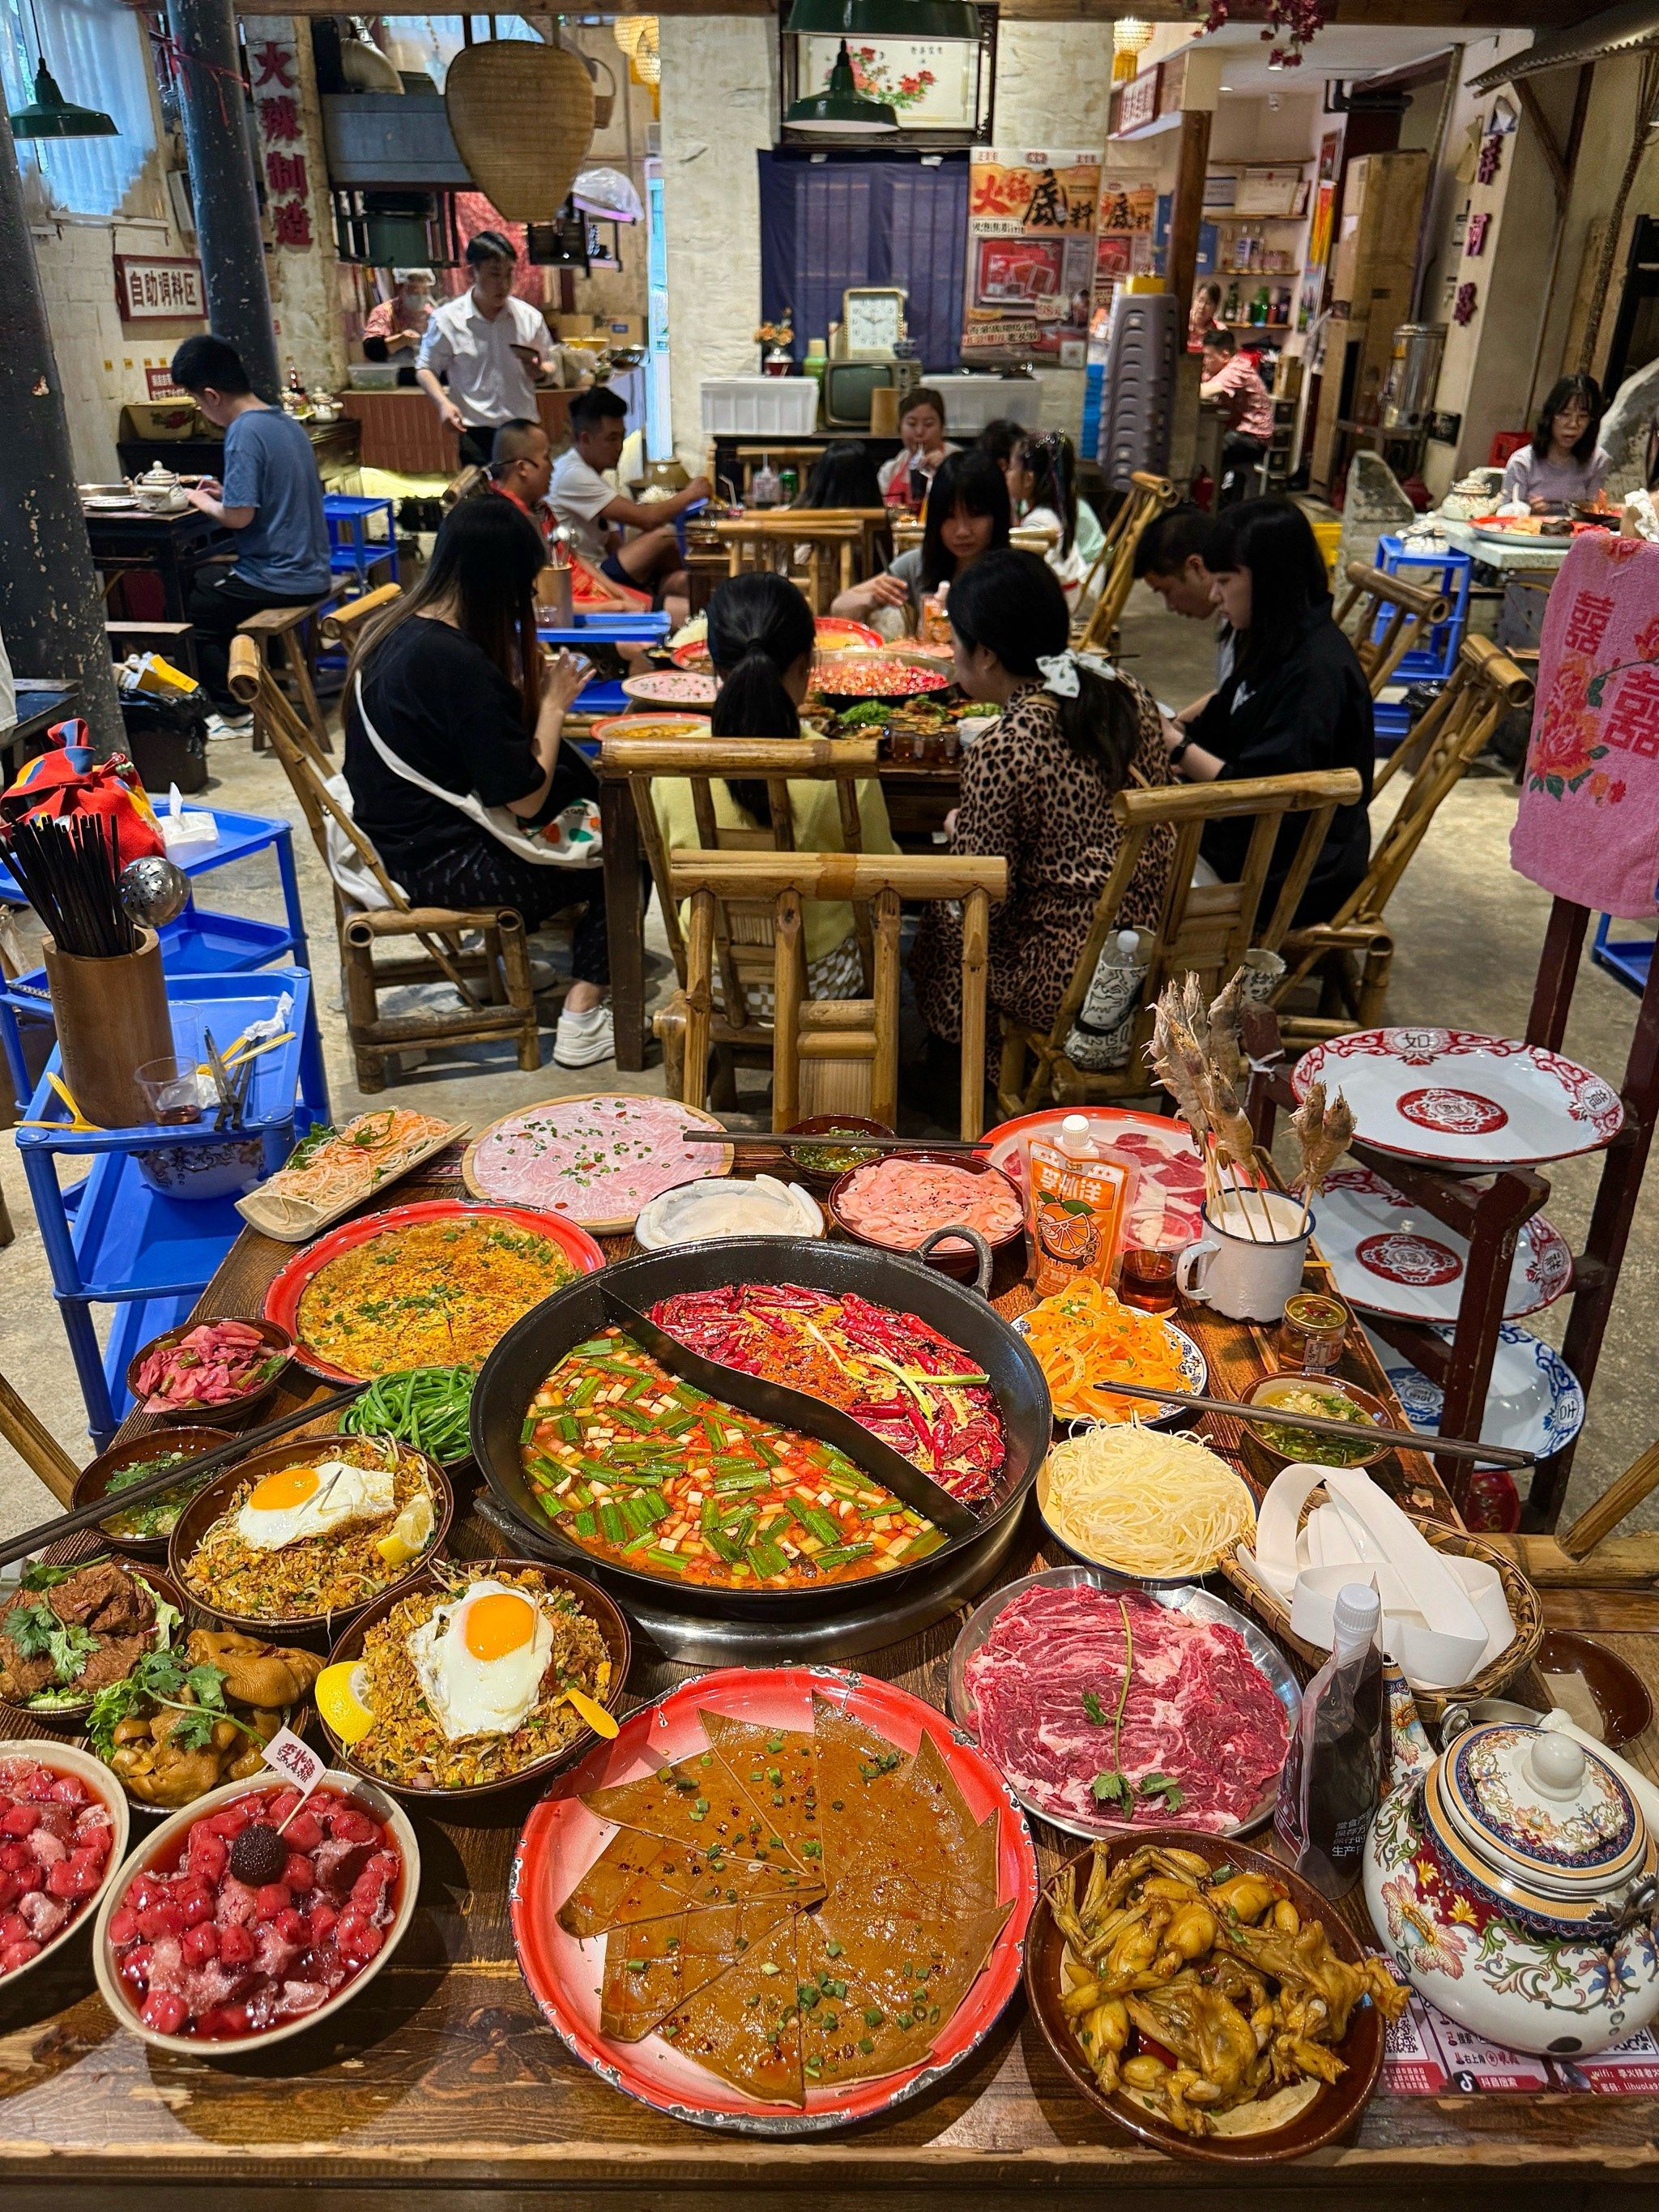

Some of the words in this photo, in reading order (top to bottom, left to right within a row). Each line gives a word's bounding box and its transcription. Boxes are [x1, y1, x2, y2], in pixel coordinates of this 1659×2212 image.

[254, 41, 313, 246] 火辣制造
[130, 271, 196, 306] 自助调料区
[1565, 591, 1614, 655] 囍
[1402, 1032, 1430, 1049] 如
